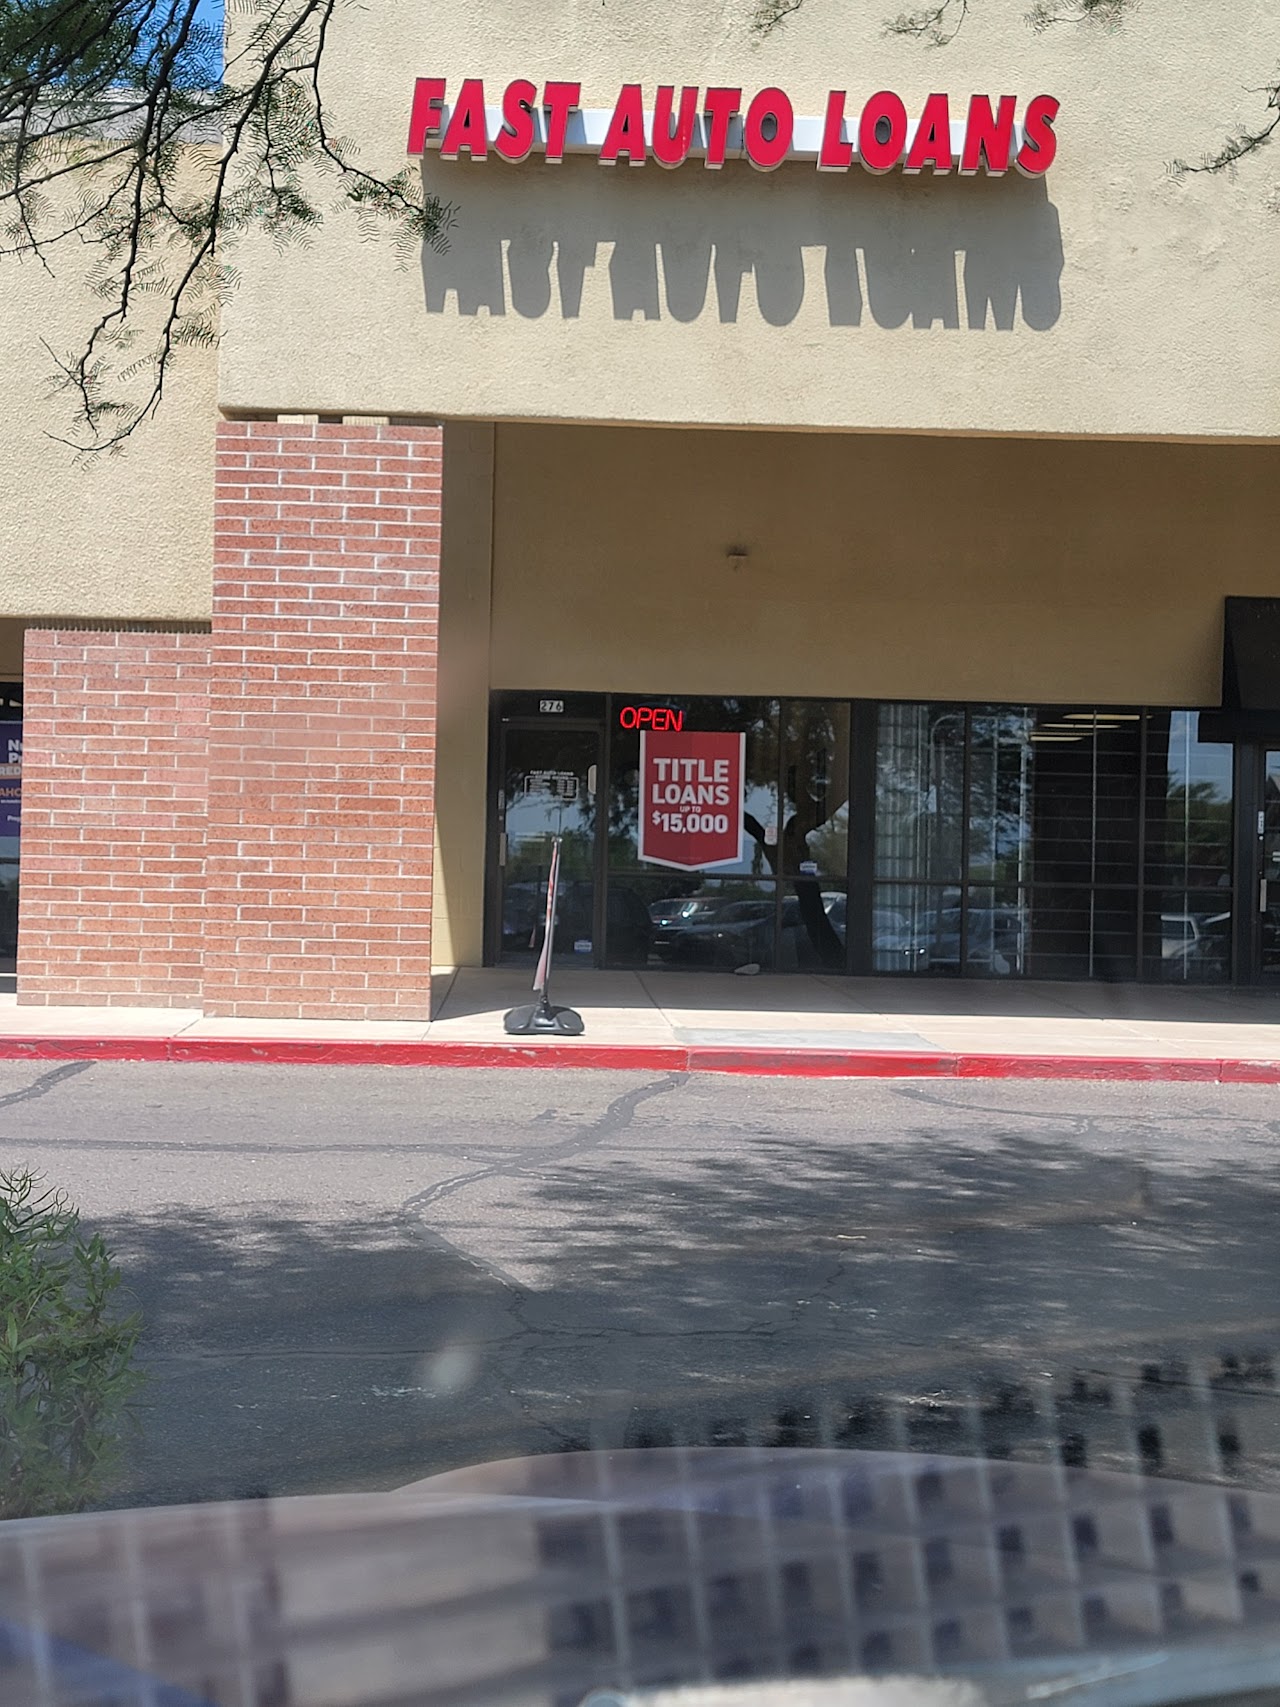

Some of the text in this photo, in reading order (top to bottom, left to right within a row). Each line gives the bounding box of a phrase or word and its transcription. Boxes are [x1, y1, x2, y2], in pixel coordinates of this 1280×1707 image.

[408, 77, 1060, 177] FAST AUTO LOANS
[541, 701, 562, 711] 276
[619, 706, 683, 732] OPEN
[653, 758, 729, 782] TITLE
[652, 783, 730, 805] LOANS
[680, 805, 701, 813] UP TO
[652, 810, 728, 833] $15,000
